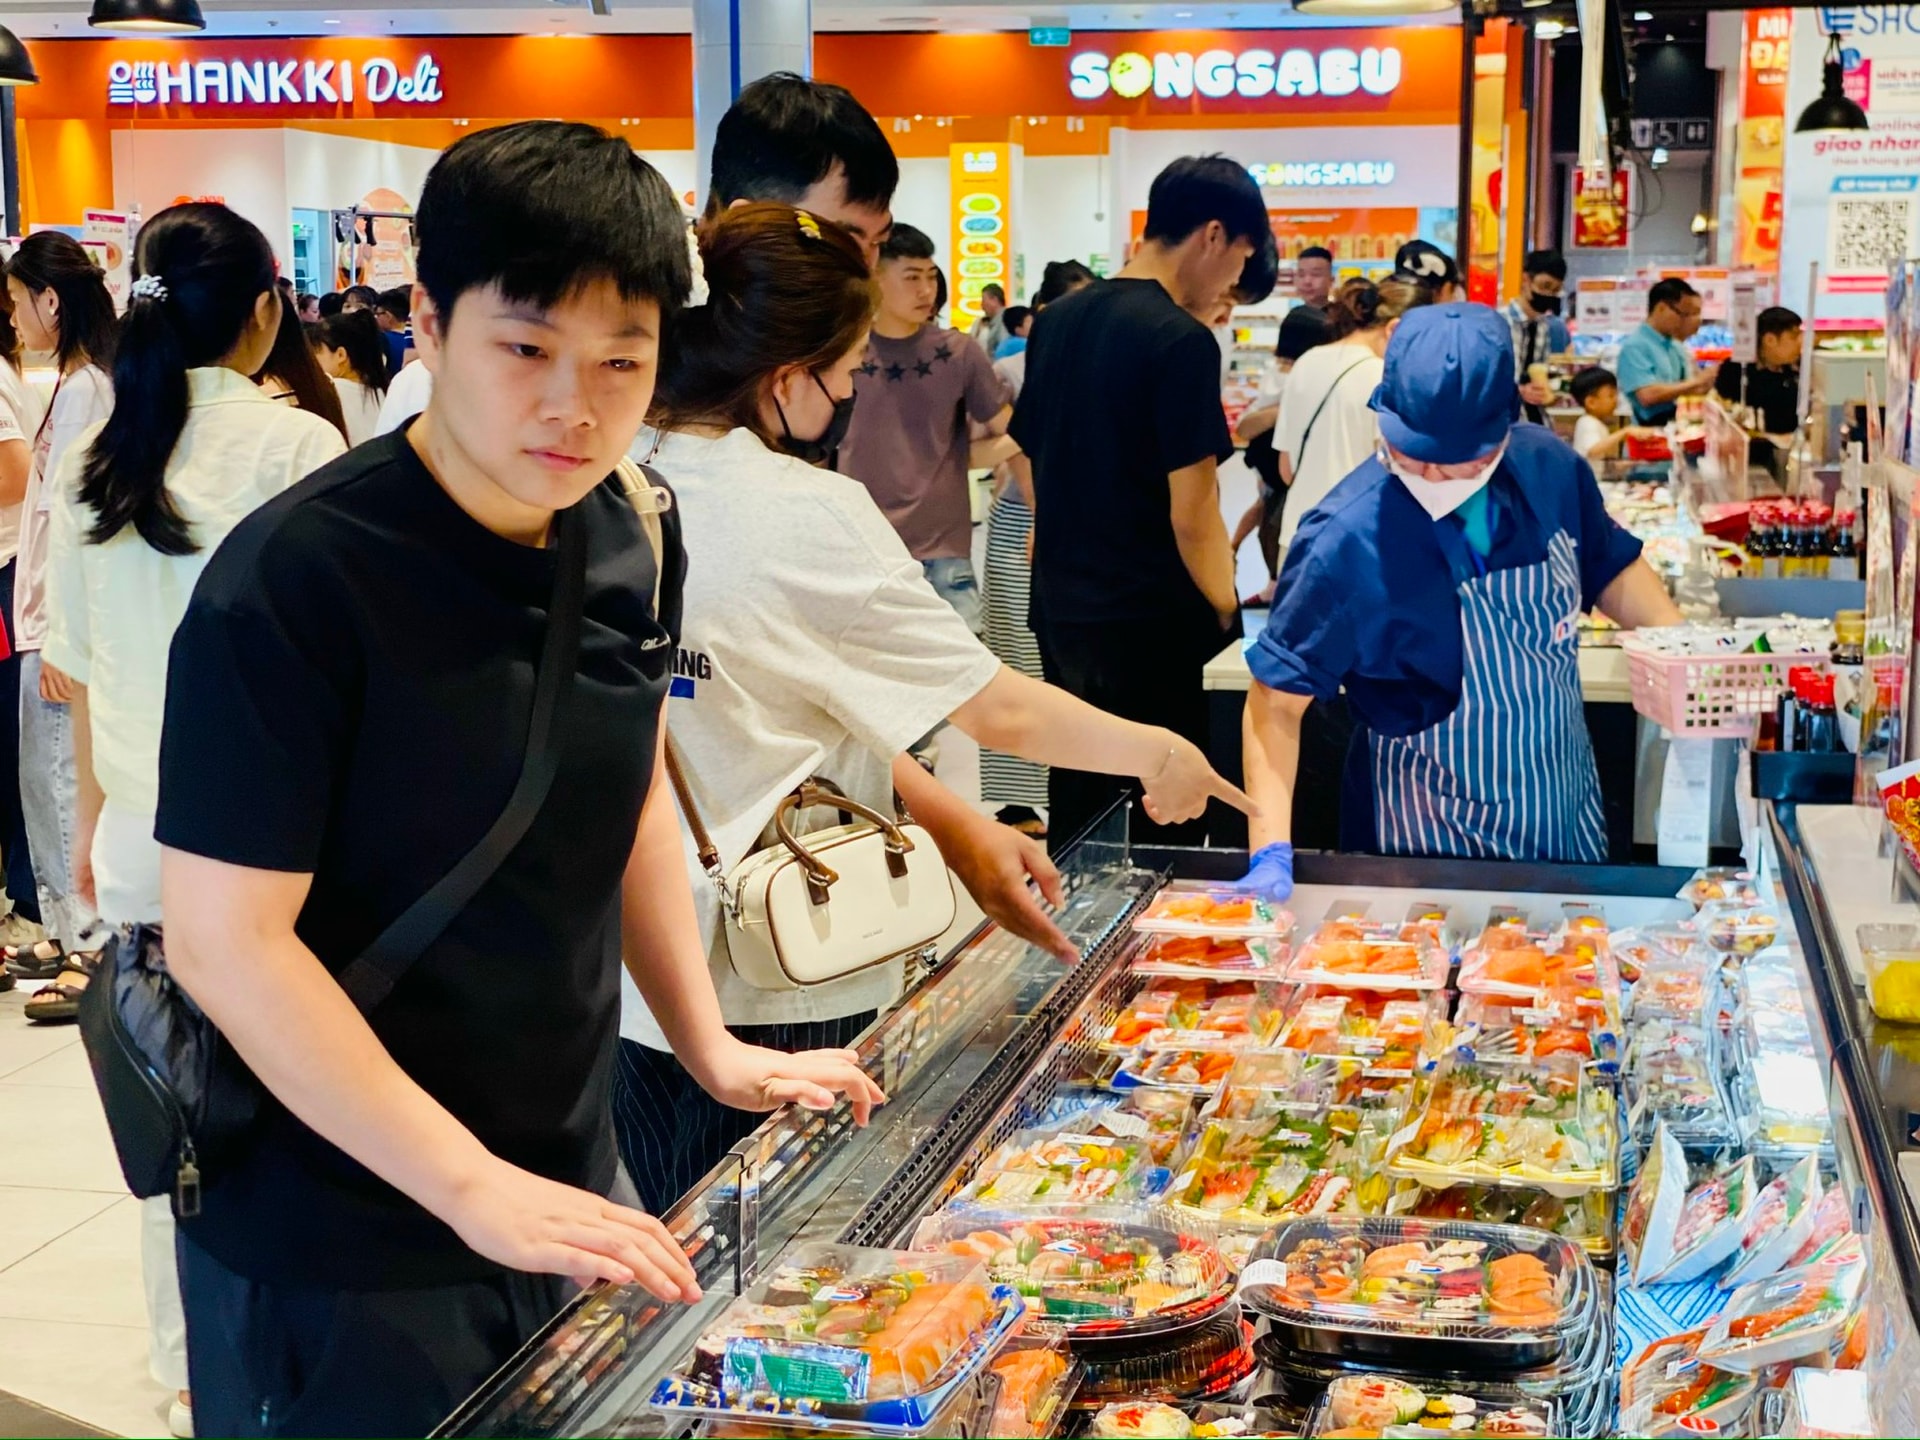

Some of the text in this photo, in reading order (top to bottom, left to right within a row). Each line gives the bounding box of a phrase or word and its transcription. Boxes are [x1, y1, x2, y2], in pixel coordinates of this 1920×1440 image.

[157, 54, 443, 104] HANKKI Deli
[1069, 47, 1402, 99] SONGSABU
[1249, 160, 1396, 187] SONGSABU
